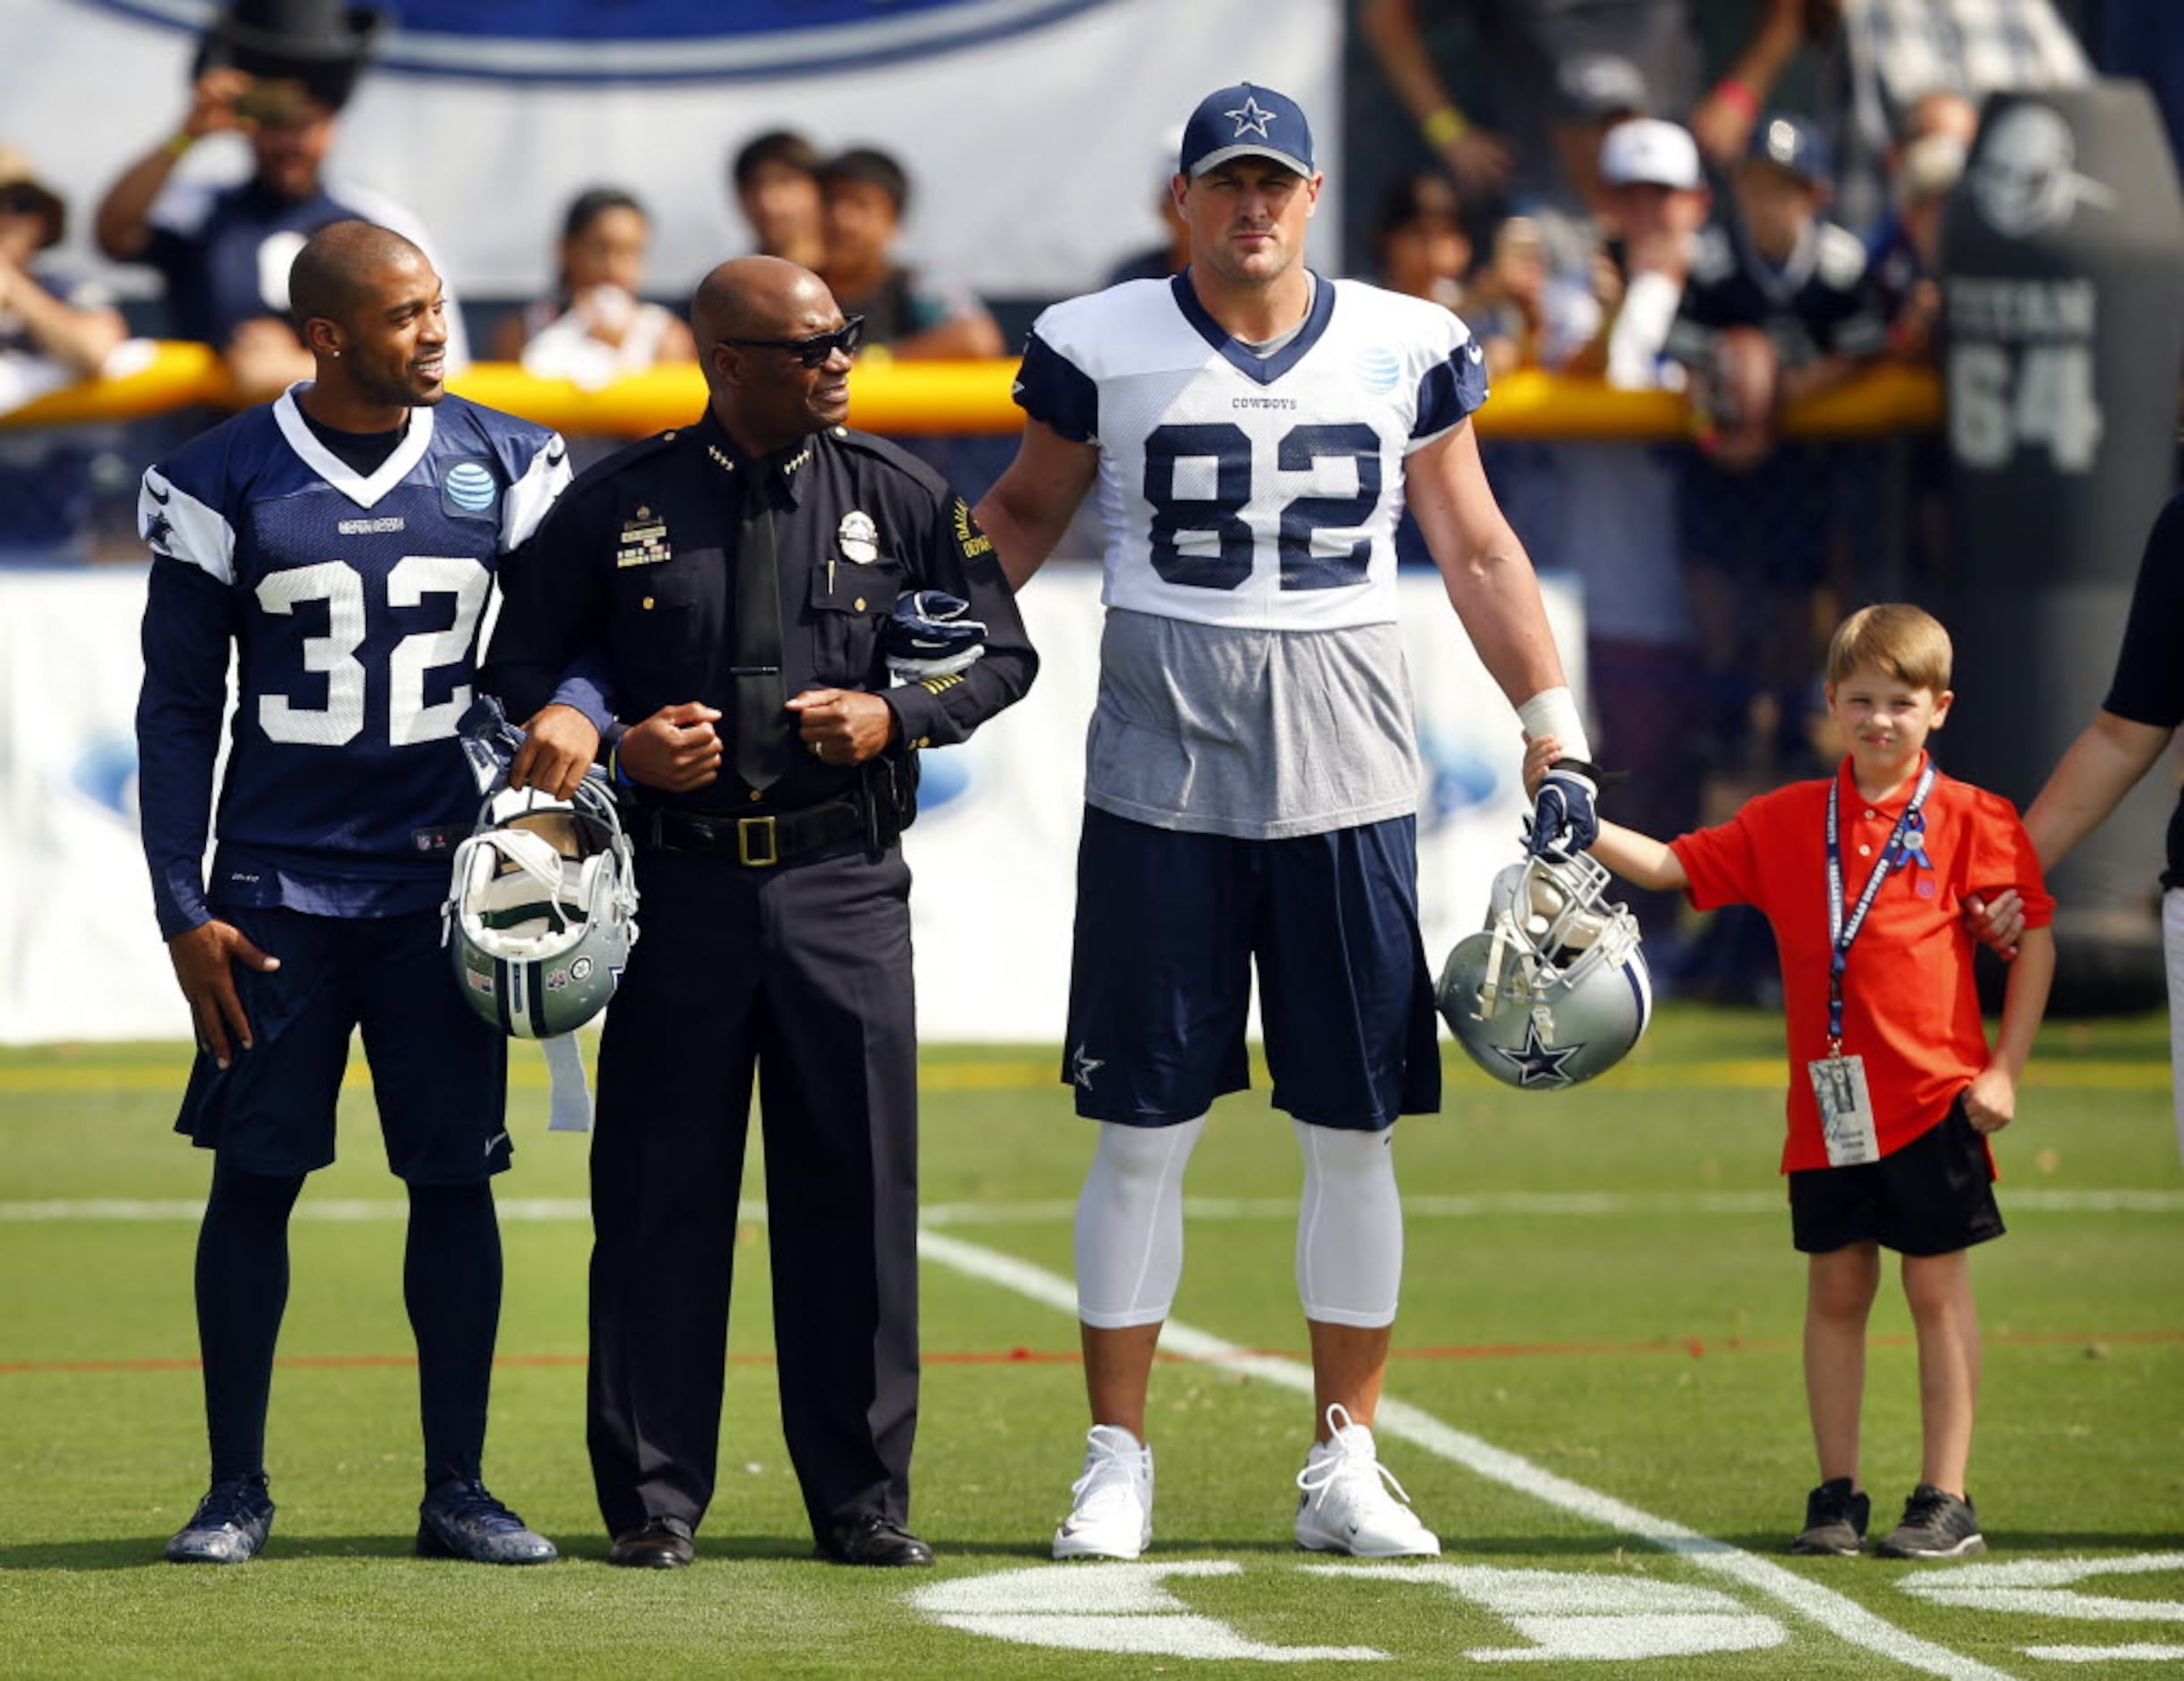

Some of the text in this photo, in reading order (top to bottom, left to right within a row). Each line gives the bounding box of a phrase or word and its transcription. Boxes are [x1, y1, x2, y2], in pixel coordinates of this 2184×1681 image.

[1232, 397, 1297, 410] COWBOYS
[1949, 345, 2102, 473] 64
[1143, 422, 1382, 591] 82
[255, 555, 491, 747] 32
